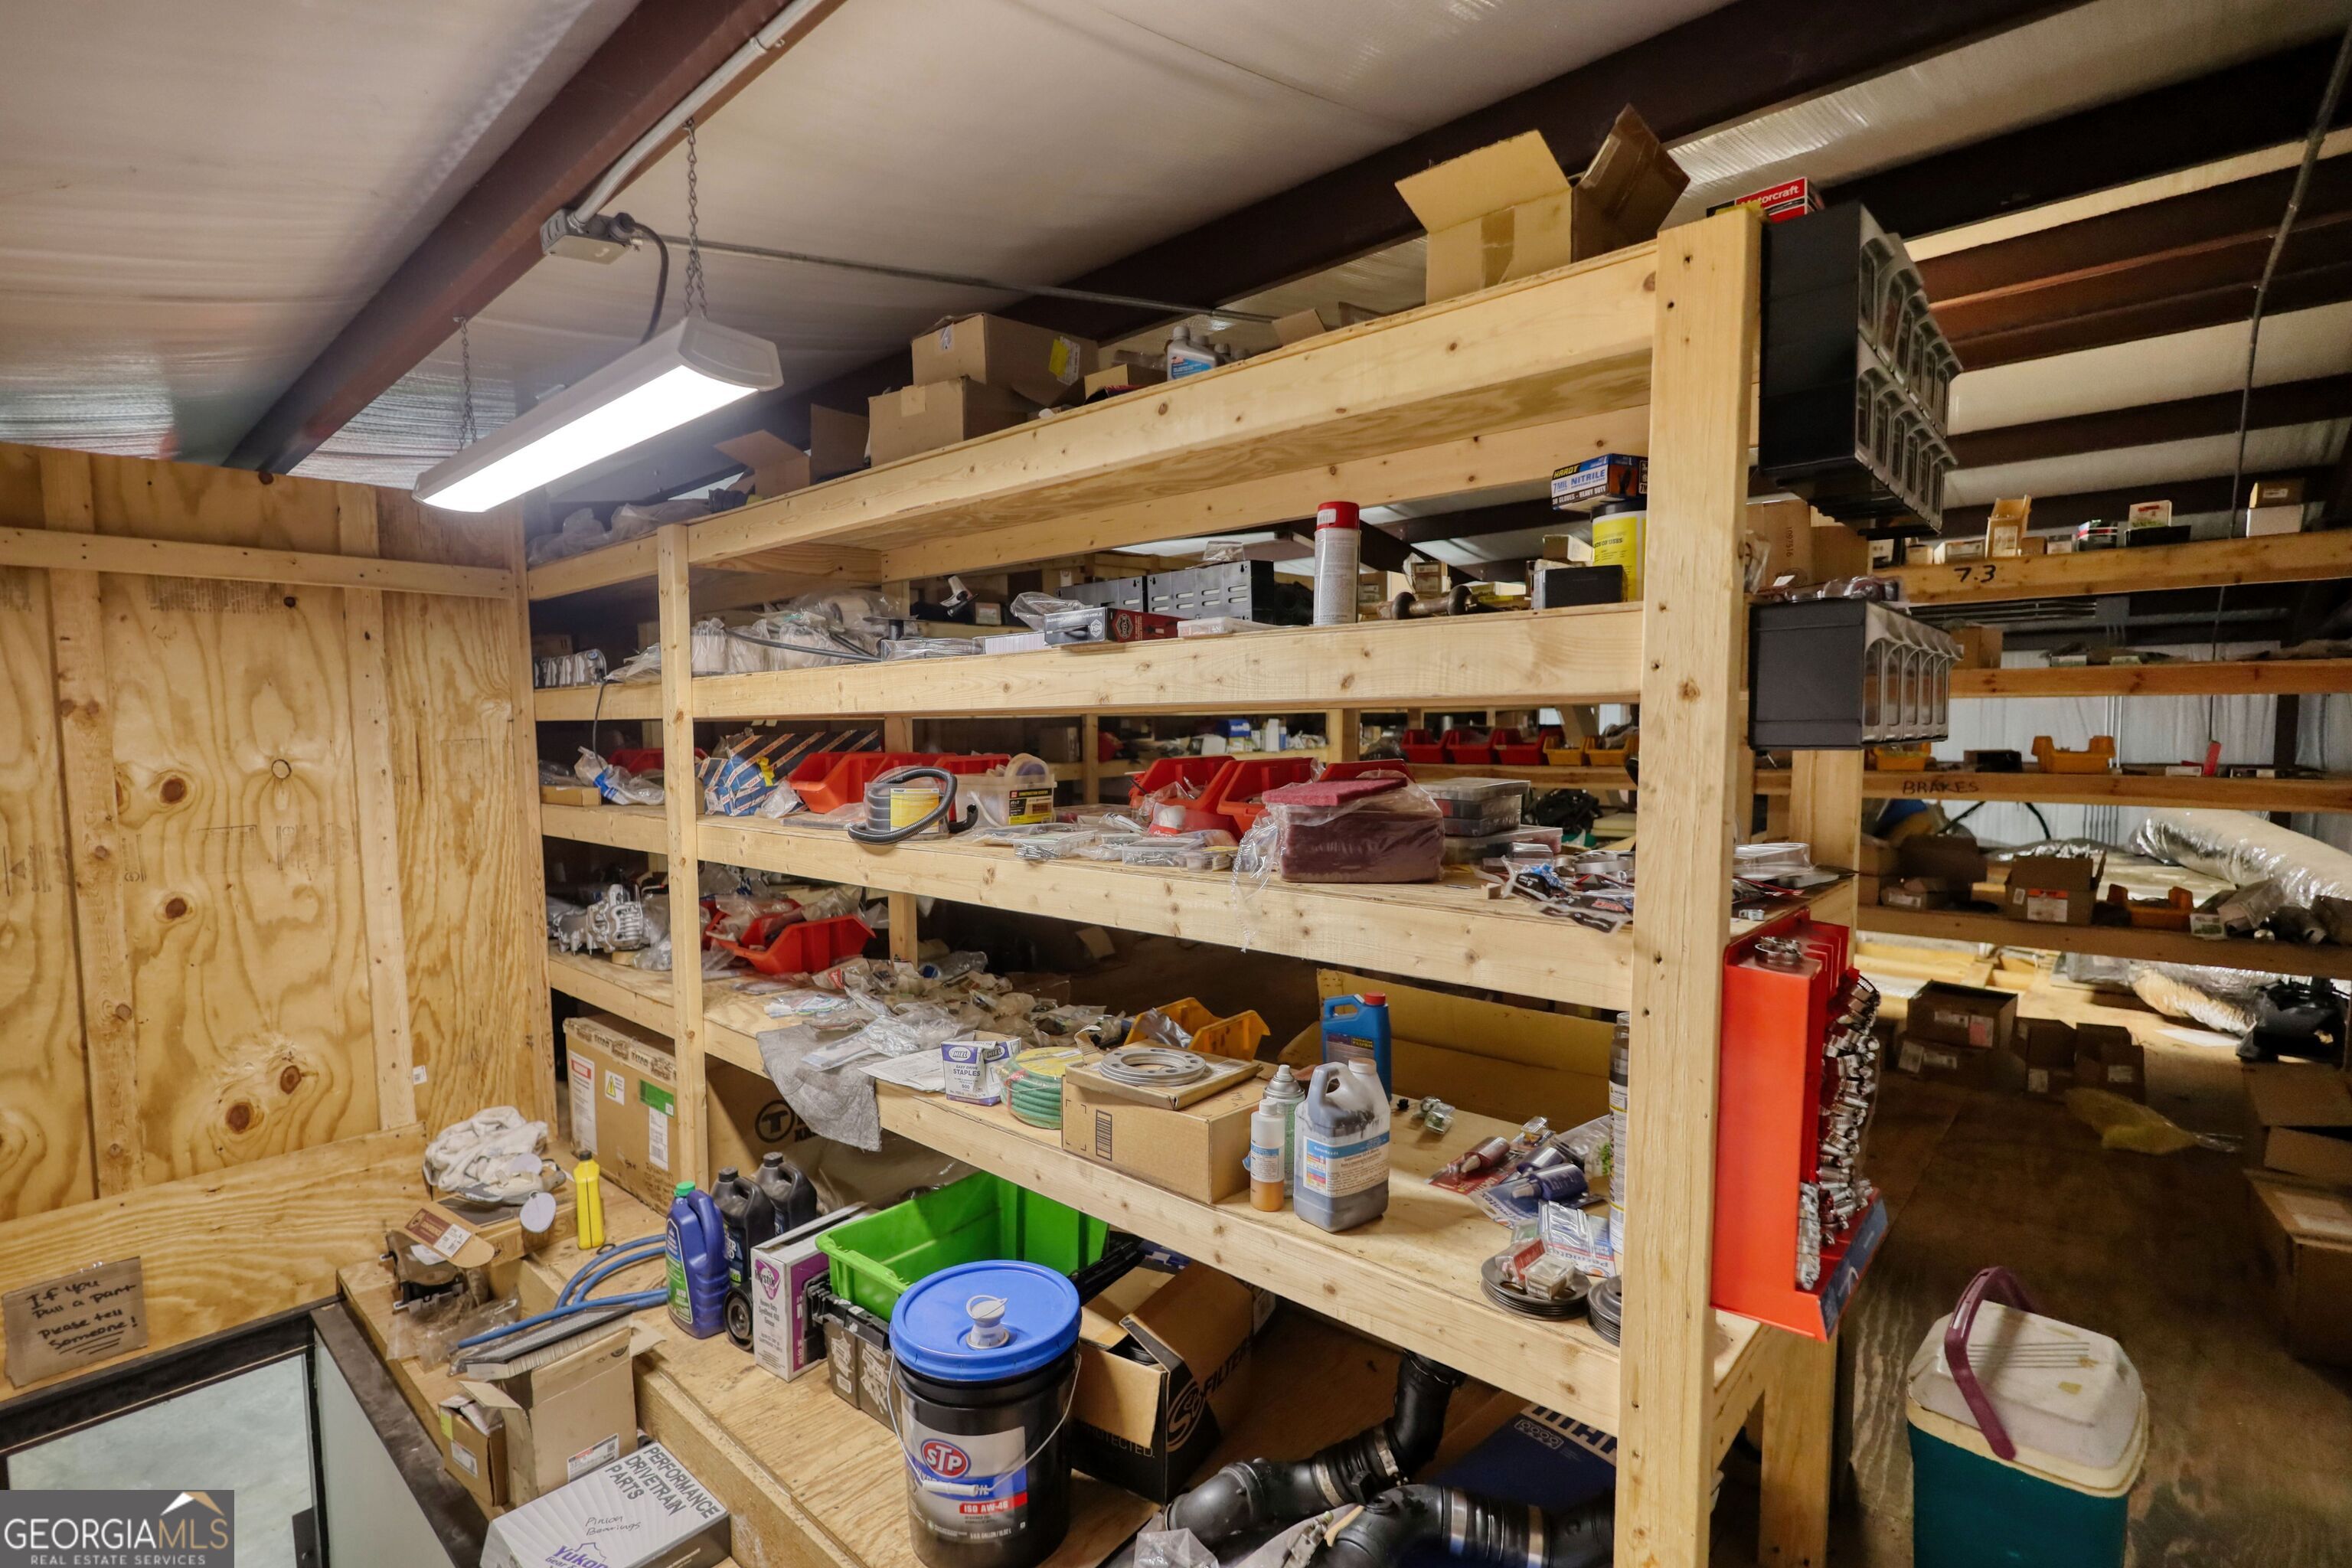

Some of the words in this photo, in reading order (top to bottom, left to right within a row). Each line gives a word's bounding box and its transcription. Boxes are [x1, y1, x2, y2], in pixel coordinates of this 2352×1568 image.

[1741, 185, 1799, 205] torcraft
[1554, 466, 1578, 479] HARDY
[1570, 469, 1606, 485] NITRILE
[1559, 494, 1575, 503] GLOVES
[1579, 488, 1593, 498] HEAVY
[1594, 485, 1606, 495] DUTY
[1954, 565, 1996, 583] 7.3
[1903, 779, 1979, 795] BRAKES
[26, 1288, 58, 1309] If
[65, 1280, 100, 1293] you
[94, 1309, 122, 1321] tell
[926, 1445, 962, 1472] STP
[605, 1465, 645, 1500] PARTS
[625, 1455, 687, 1516] DRIVETRAIN
[644, 1446, 720, 1519] PERFORMANCE
[964, 1504, 978, 1514] ISO
[981, 1501, 1008, 1513] AW-46
[545, 1556, 567, 1567] Gear
